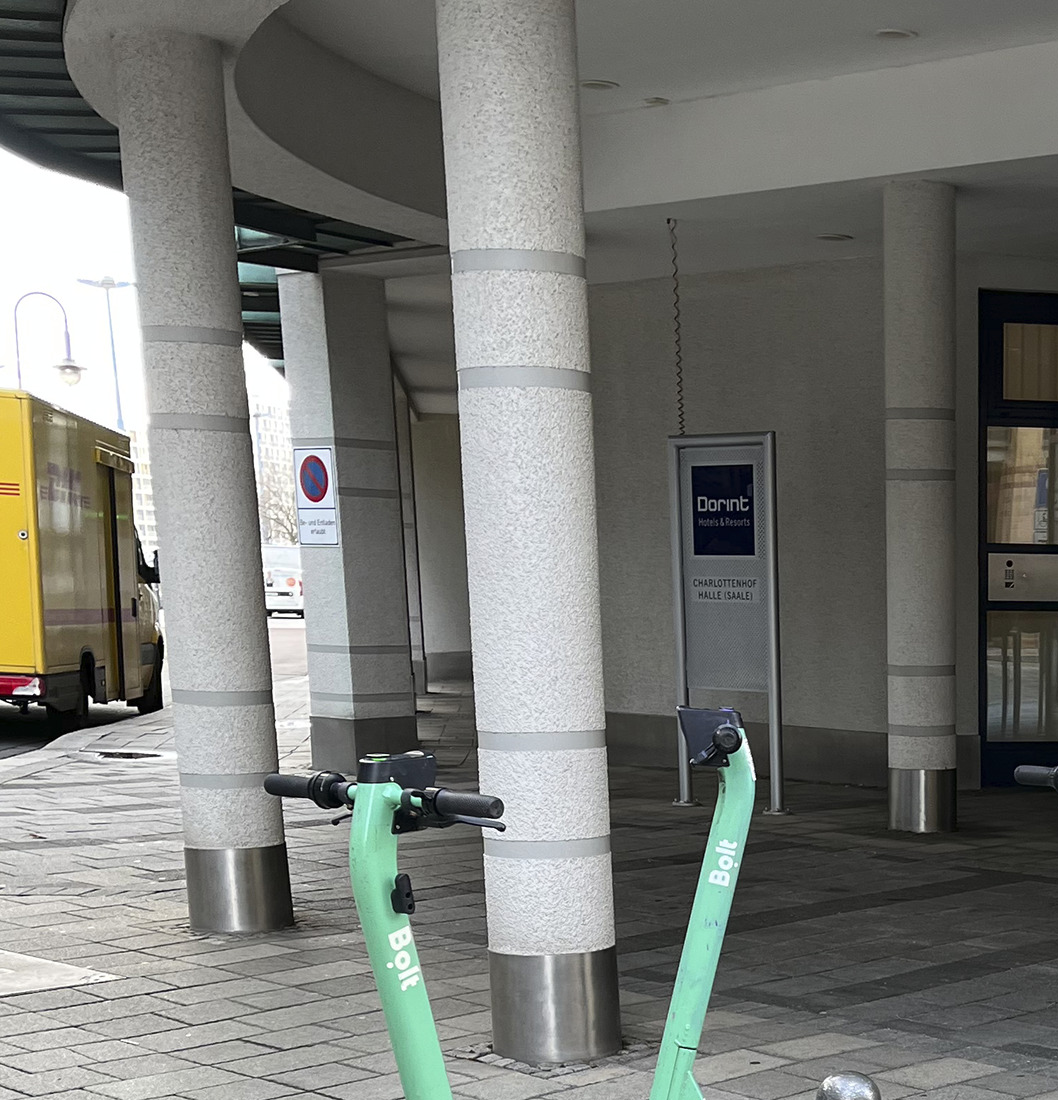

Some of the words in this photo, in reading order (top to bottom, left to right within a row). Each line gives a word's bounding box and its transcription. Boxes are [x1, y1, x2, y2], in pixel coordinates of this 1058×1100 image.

[697, 496, 750, 512] Dorint
[698, 518, 719, 527] Hotels
[725, 517, 751, 527] Resorts
[693, 578, 757, 589] CHARLOTTENHOF
[698, 591, 722, 600] HALLE
[724, 590, 753, 601] (SAALE)
[708, 838, 738, 887] Bolt
[386, 925, 421, 992] Bolt
